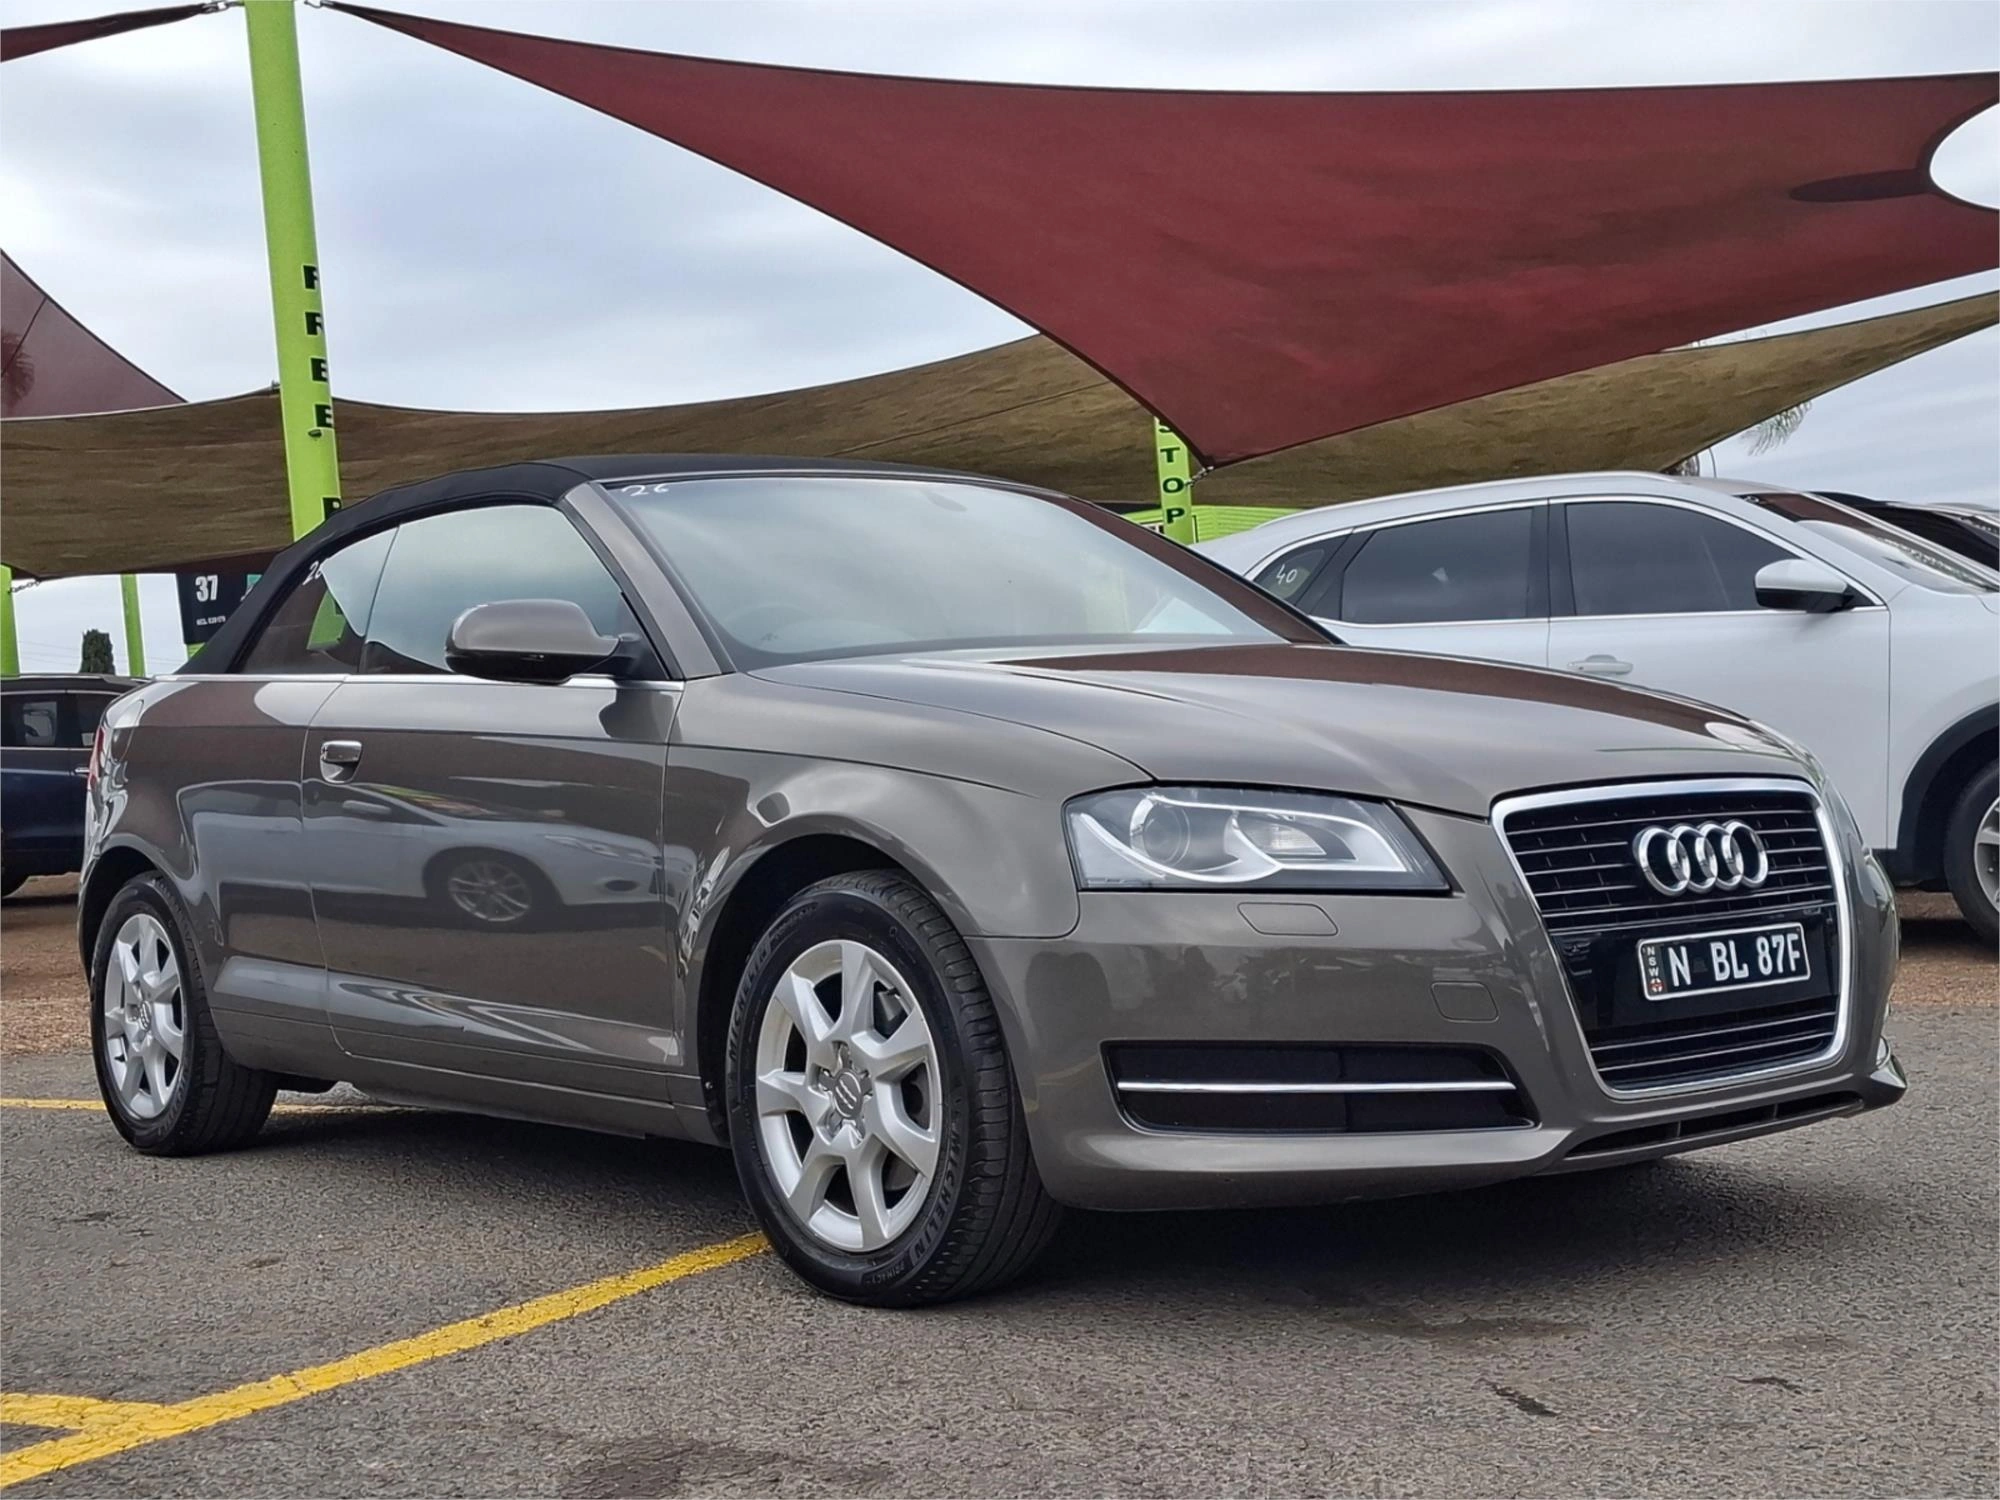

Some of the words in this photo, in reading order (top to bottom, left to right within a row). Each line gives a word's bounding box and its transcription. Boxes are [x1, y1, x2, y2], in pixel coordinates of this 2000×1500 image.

[303, 265, 333, 427] FREE
[621, 483, 669, 496] 26
[195, 575, 218, 602] 37
[1276, 564, 1297, 585] 40
[1647, 946, 1659, 976] NSW
[1668, 946, 1691, 986] N
[1710, 941, 1749, 981] BL
[1756, 933, 1800, 975] 87F
